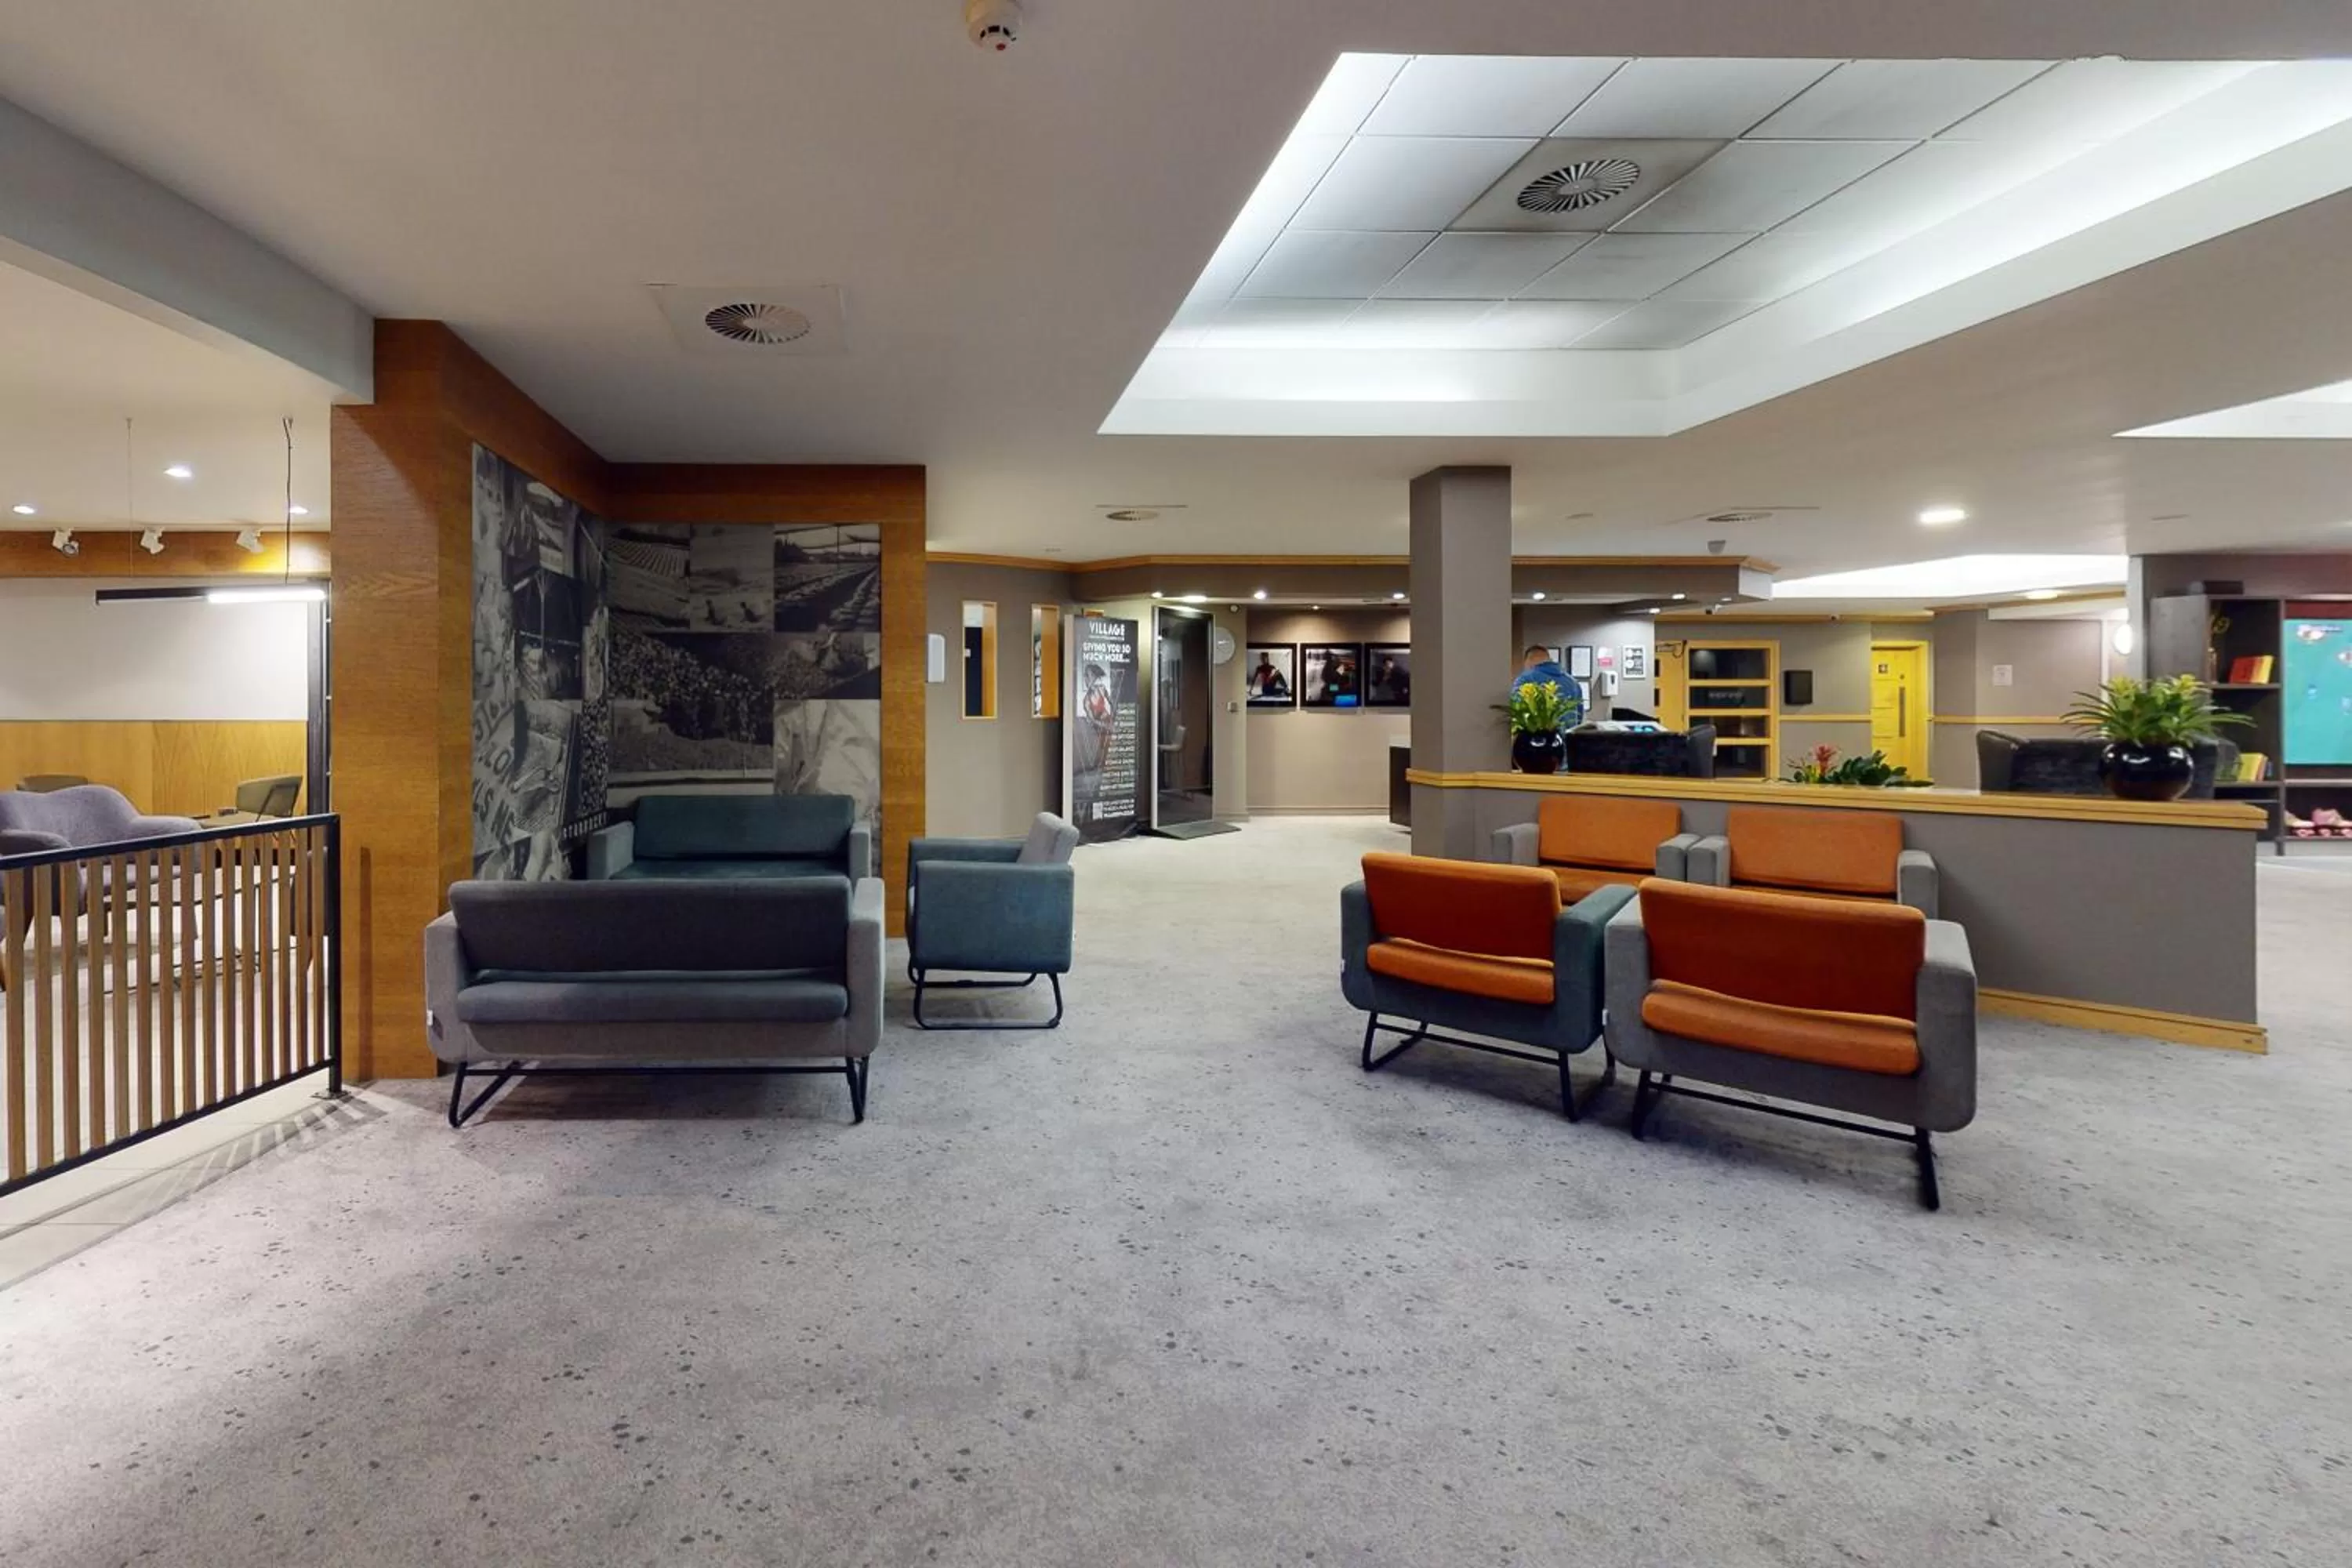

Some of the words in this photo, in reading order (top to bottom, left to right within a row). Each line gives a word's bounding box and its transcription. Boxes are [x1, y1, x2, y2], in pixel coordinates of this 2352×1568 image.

[1089, 621, 1125, 636] VILLAGE
[1107, 643, 1121, 653] YOU
[1122, 644, 1131, 654] SO
